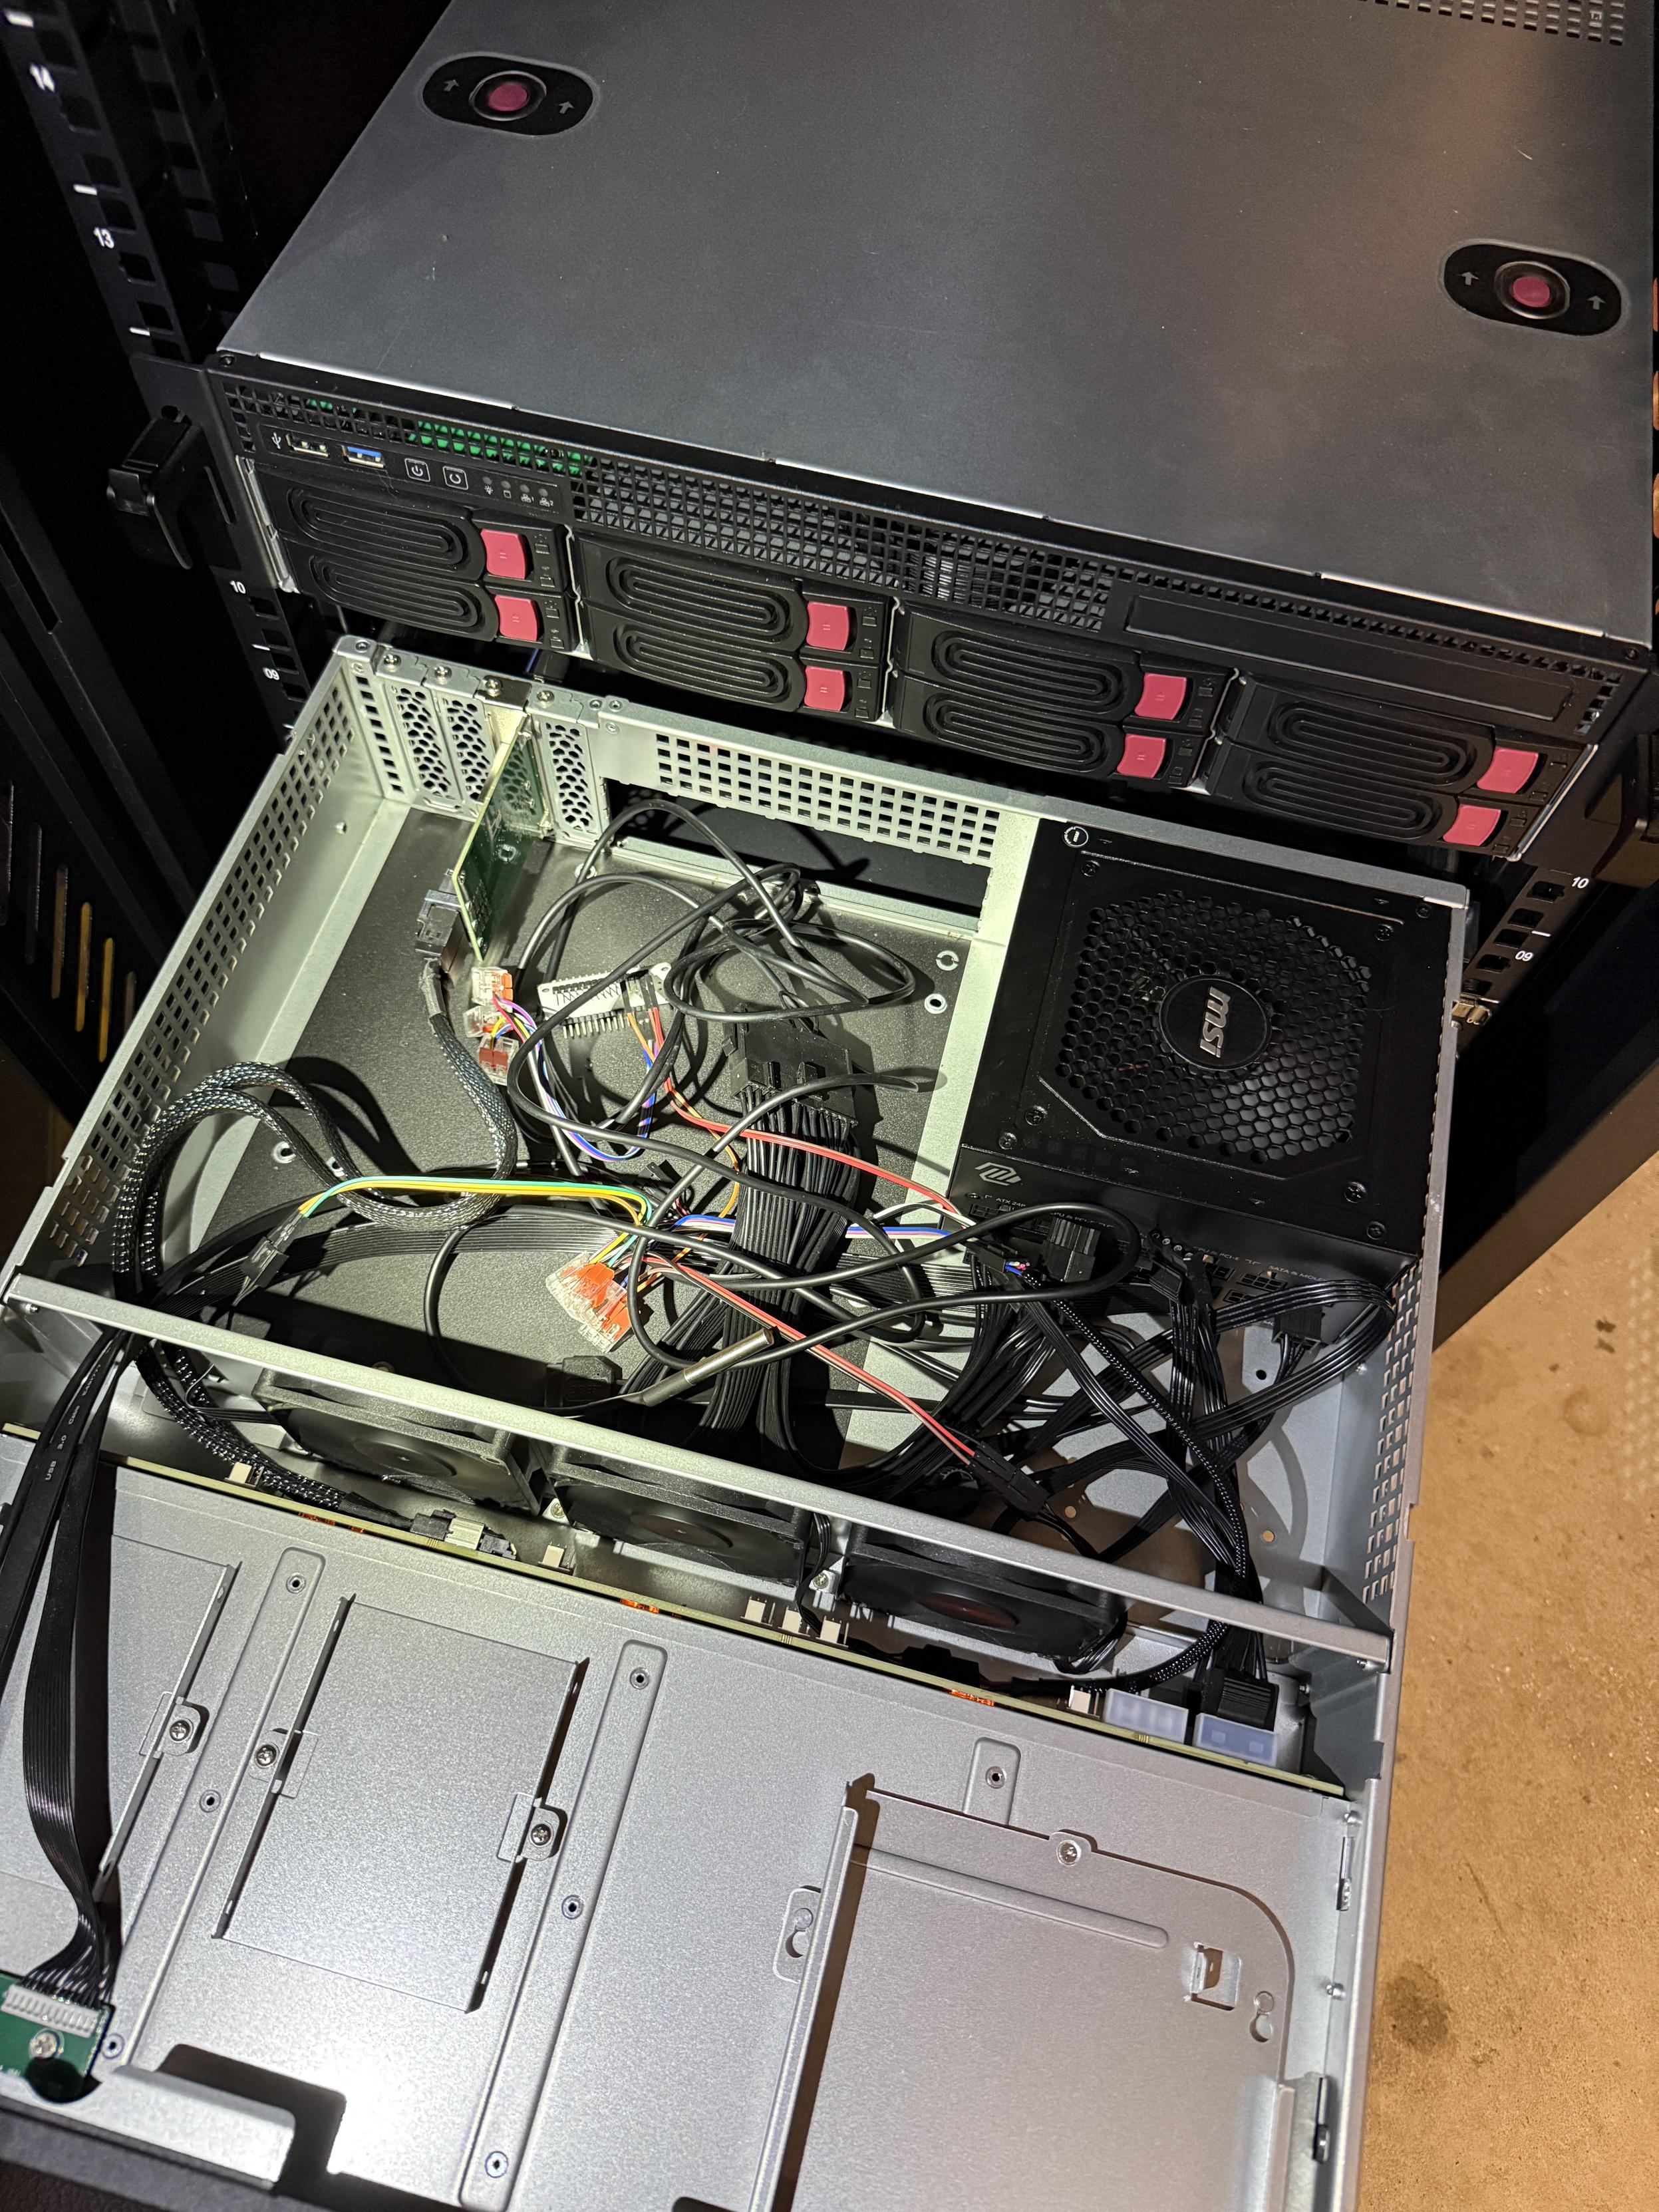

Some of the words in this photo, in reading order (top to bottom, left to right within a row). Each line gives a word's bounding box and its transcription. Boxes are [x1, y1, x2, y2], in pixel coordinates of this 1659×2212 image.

[93, 227, 115, 249] 13
[229, 580, 246, 594] 10
[262, 667, 280, 681] 09
[1571, 876, 1589, 889] 10
[1515, 950, 1533, 962] 09
[45, 1460, 57, 1481] USB
[57, 1435, 67, 1450] 3.0
